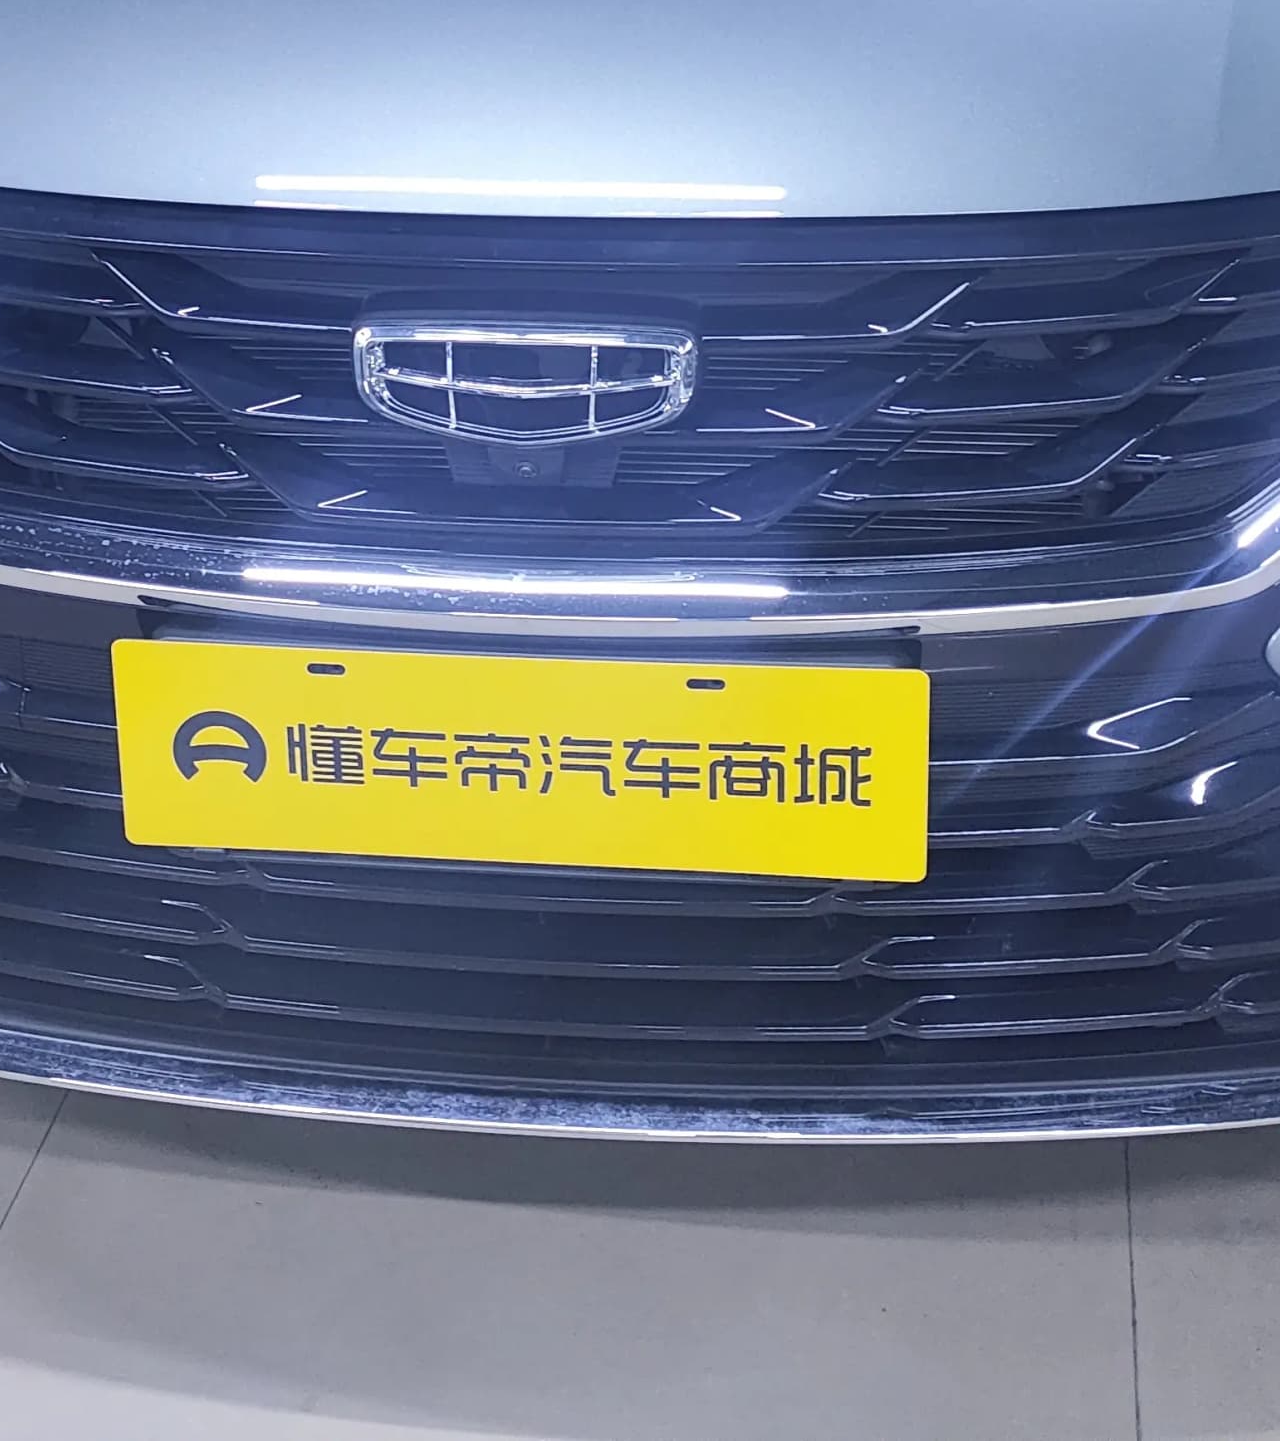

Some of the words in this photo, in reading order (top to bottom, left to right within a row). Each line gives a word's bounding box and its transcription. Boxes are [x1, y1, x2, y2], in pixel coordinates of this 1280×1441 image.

[286, 721, 872, 807] 懂车帝汽车商城
